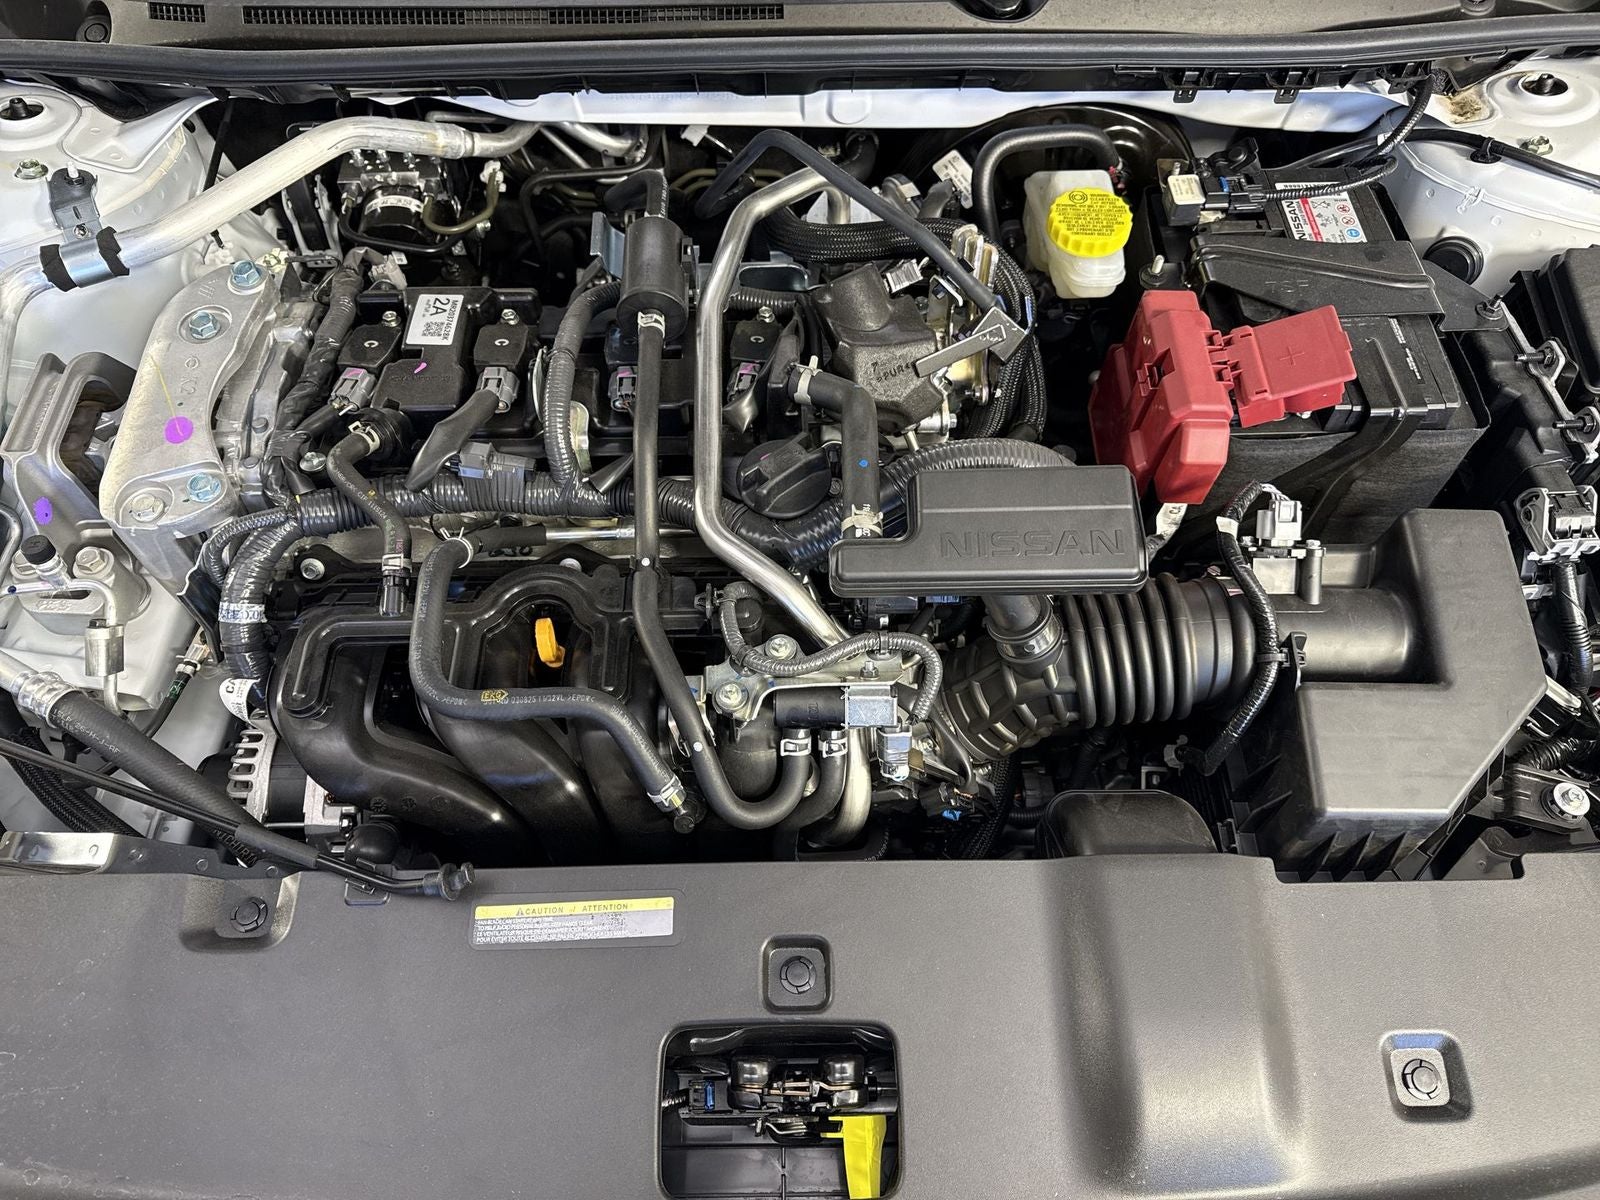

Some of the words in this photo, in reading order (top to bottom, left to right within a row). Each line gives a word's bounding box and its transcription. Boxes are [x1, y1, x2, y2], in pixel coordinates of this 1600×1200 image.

[1285, 200, 1307, 240] NISSAN
[430, 297, 451, 317] 2A
[940, 529, 1126, 558] NISSAN
[525, 906, 564, 915] CAUTION
[582, 902, 629, 912] ATTENTION
